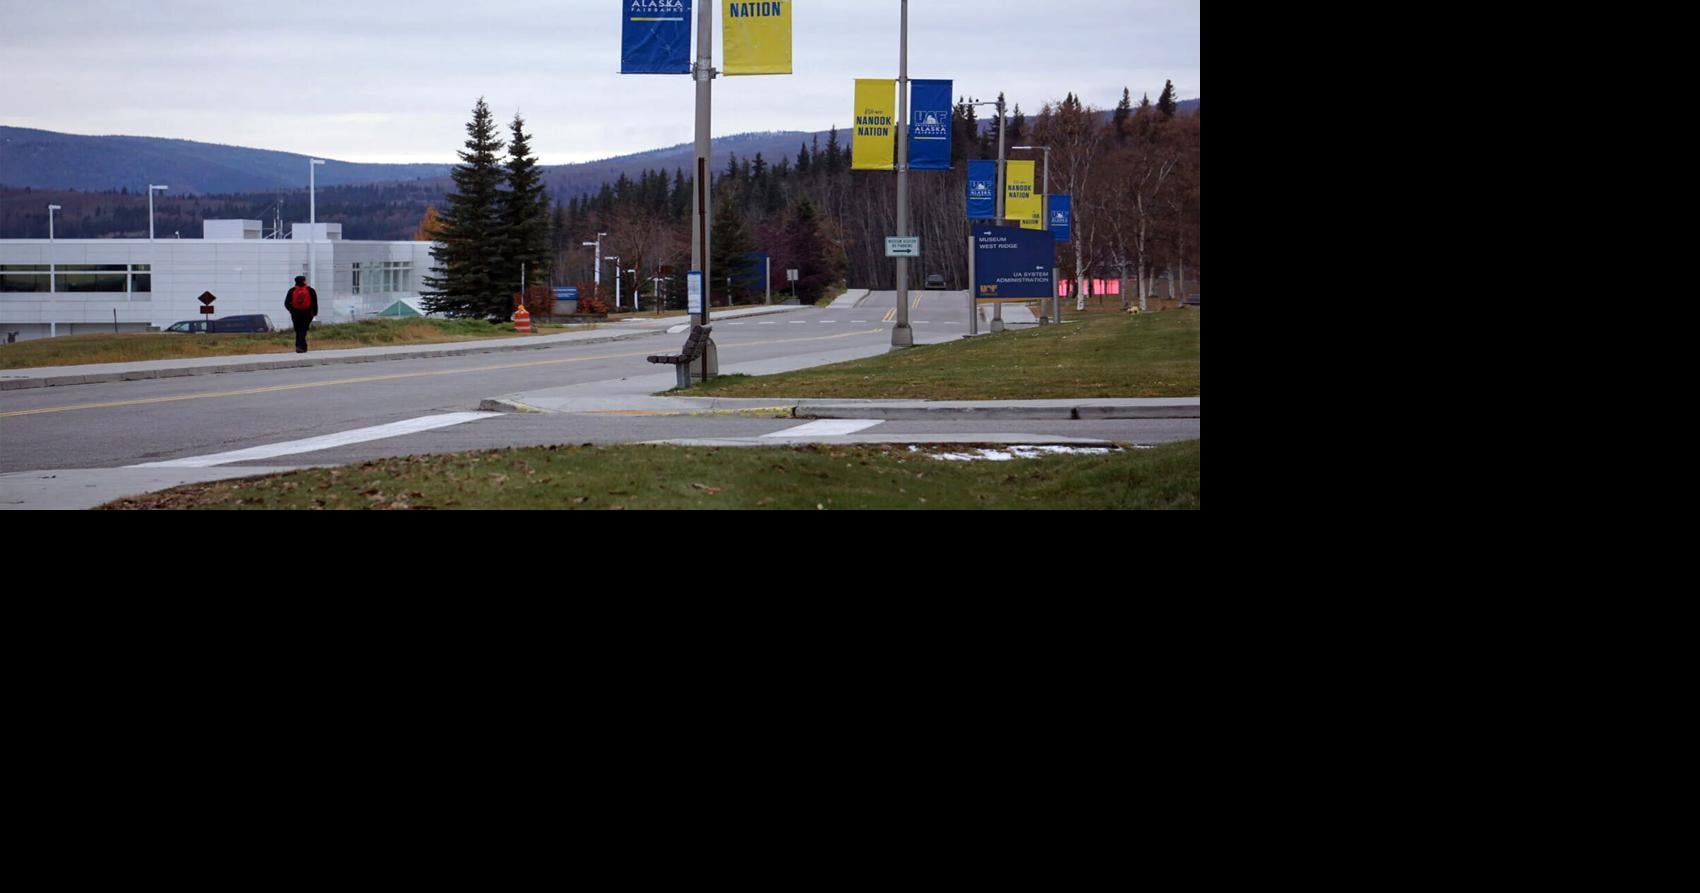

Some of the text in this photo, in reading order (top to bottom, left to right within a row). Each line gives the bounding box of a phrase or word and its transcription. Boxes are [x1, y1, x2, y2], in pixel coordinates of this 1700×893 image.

[730, 2, 781, 17] NATION
[856, 116, 892, 125] NANOOK
[858, 127, 888, 136] NATION
